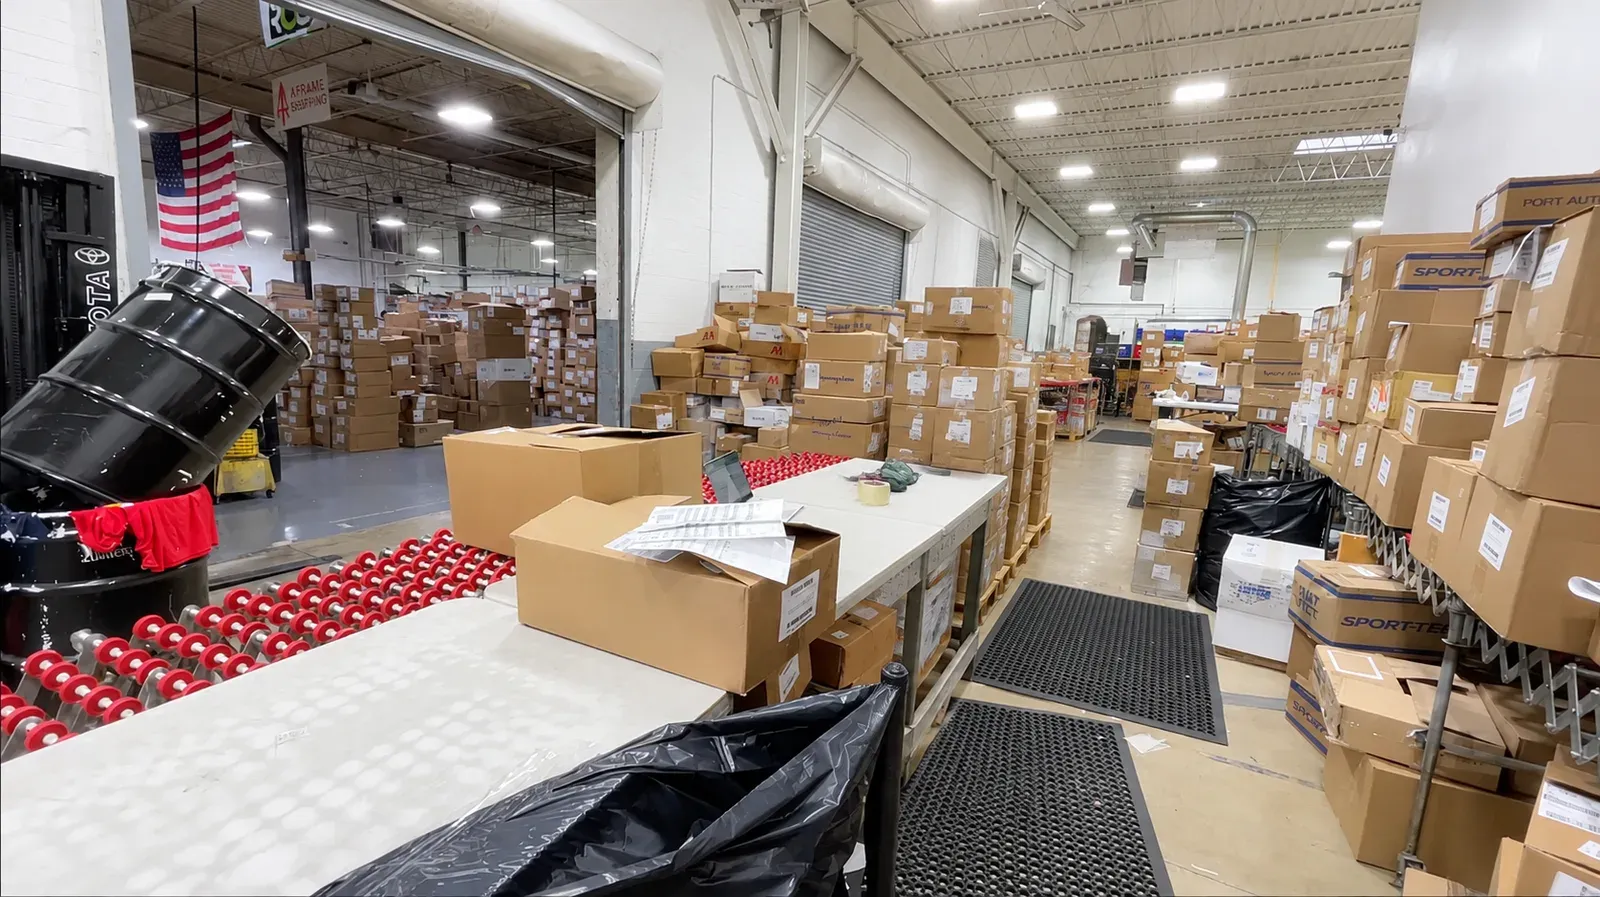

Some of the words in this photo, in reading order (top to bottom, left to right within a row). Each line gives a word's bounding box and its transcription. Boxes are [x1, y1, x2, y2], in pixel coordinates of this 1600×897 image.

[290, 79, 325, 98] AFRAME
[1522, 197, 1564, 208] PORT
[1566, 195, 1600, 205] AUT
[86, 270, 112, 332] OTA
